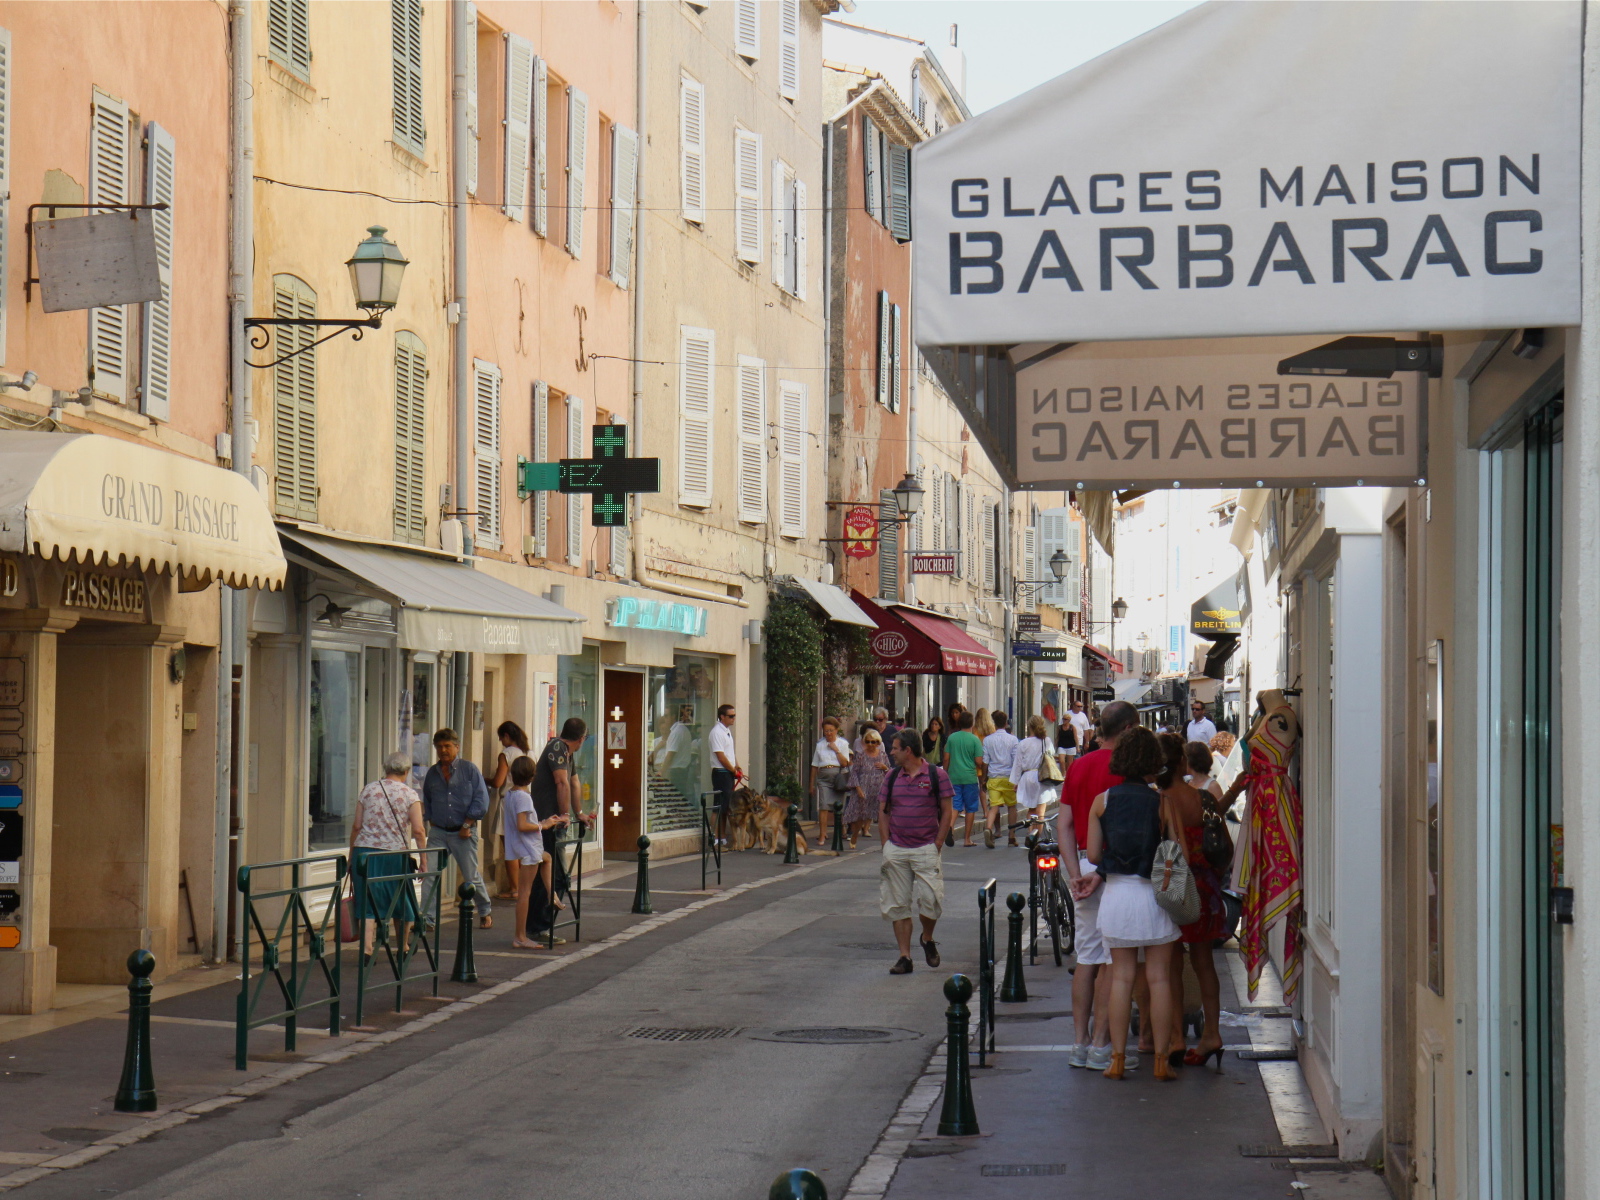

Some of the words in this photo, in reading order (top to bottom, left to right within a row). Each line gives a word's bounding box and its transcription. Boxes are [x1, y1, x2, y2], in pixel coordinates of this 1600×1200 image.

[951, 170, 1221, 218] GLACES
[1260, 153, 1540, 208] MAISON
[949, 209, 1543, 295] BARBARAC
[101, 473, 163, 526] GRAND
[174, 490, 239, 542] PASSAGE
[913, 558, 953, 572] BOUCHERIE
[65, 569, 144, 613] PASSAGE
[482, 616, 520, 648] Paparazzi
[901, 660, 936, 670] Traiteur
